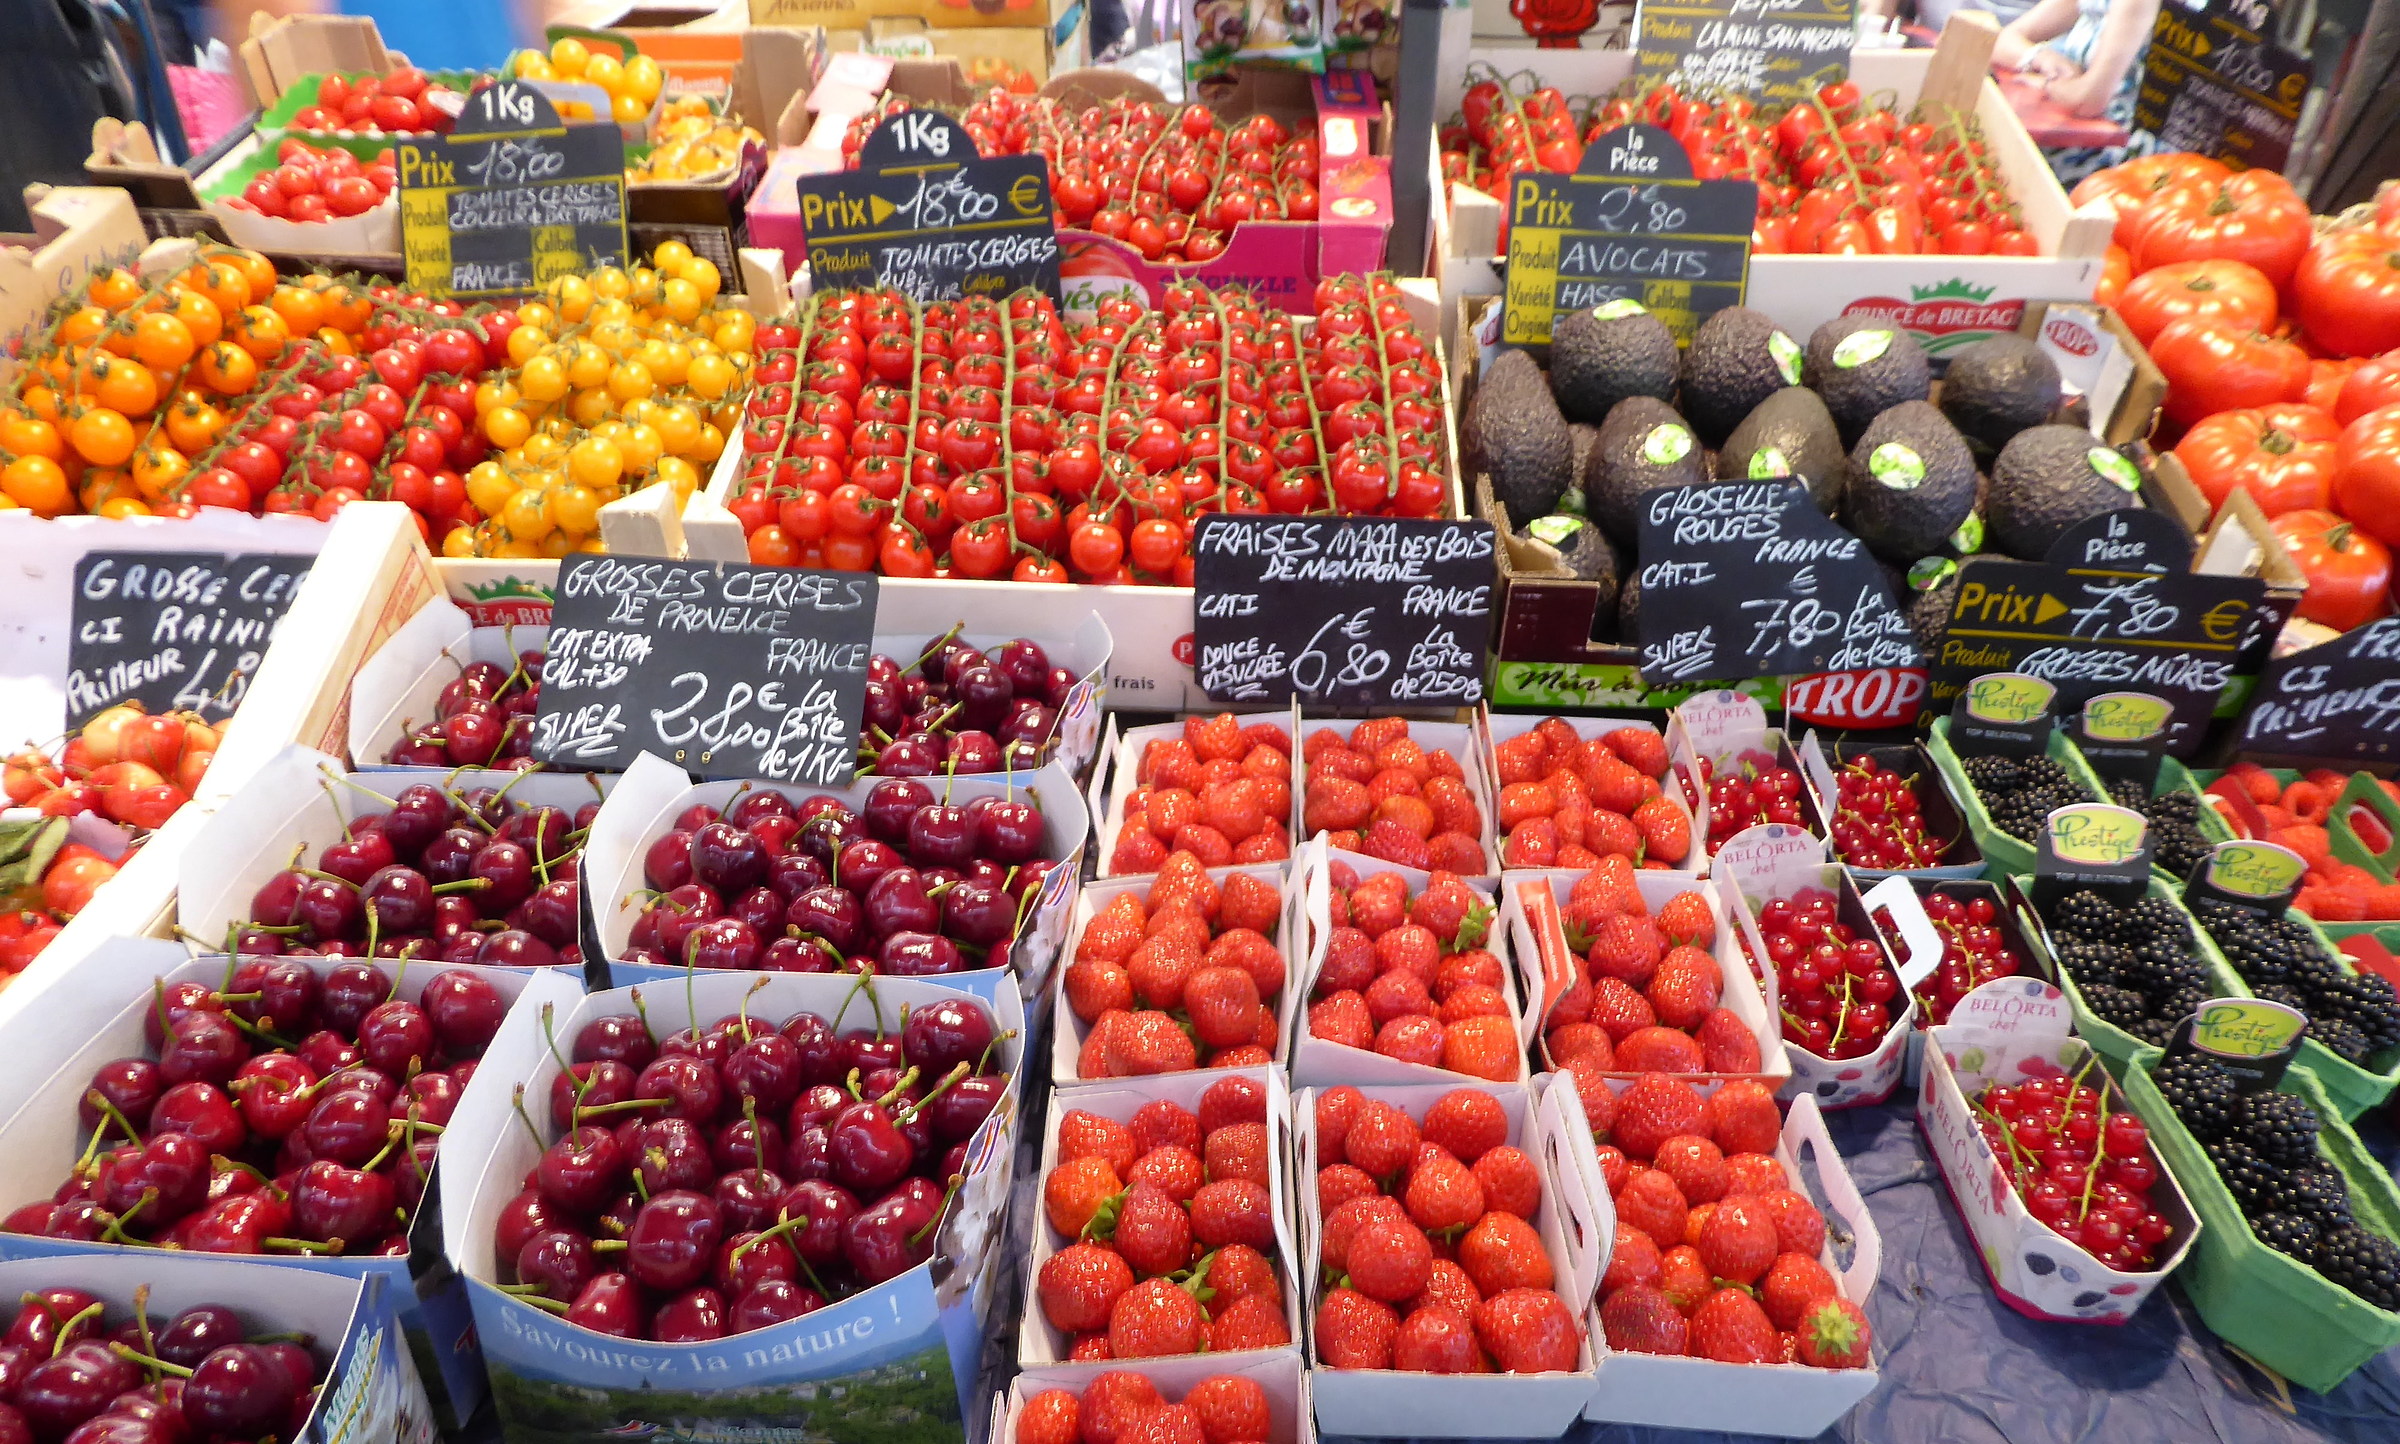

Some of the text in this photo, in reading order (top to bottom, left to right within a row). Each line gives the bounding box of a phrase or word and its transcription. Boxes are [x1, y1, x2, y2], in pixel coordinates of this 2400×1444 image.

[400, 145, 456, 186] Prix
[1611, 147, 1660, 173] Pièce
[803, 191, 867, 231] Prix
[1008, 175, 1044, 215] €
[1516, 180, 1575, 226] Prix
[811, 248, 872, 275] Produit
[1560, 241, 1709, 278] AVOCATS
[1326, 523, 1398, 562] MARA
[1400, 535, 1438, 561] DES
[1673, 512, 1782, 546] ROUGES
[1259, 554, 1299, 582] DE
[1754, 536, 1862, 563] FRANCE
[2085, 538, 2146, 563] Pièce
[83, 558, 229, 606] GROSSE
[564, 558, 710, 600] GROSSES
[1788, 565, 1819, 595] €
[607, 592, 791, 635] DE PROVENCE
[1402, 585, 1491, 619] FRANCE
[1953, 582, 2180, 643] Prix 7,80
[2200, 599, 2250, 641] €
[1340, 606, 1376, 639] €
[1740, 598, 1843, 657] 7,80
[767, 637, 868, 676] FRANCE
[1201, 637, 1260, 672] DOUCE
[1289, 613, 1391, 698] 6,80
[1640, 624, 1717, 672] SUPER
[1941, 639, 2011, 668] Produit
[757, 681, 787, 712] €
[1114, 675, 1155, 690] frais
[2280, 664, 2332, 693] CI
[1967, 680, 2047, 723] Prestige
[2083, 699, 2163, 741] Prestige
[536, 703, 627, 750] SUPER
[2048, 814, 2144, 865] Prestige
[2209, 848, 2293, 898] Prestige
[2193, 1006, 2290, 1059] Prestige
[501, 1305, 678, 1375] Savourez
[690, 1351, 730, 1372] la
[745, 1313, 876, 1369] nature
